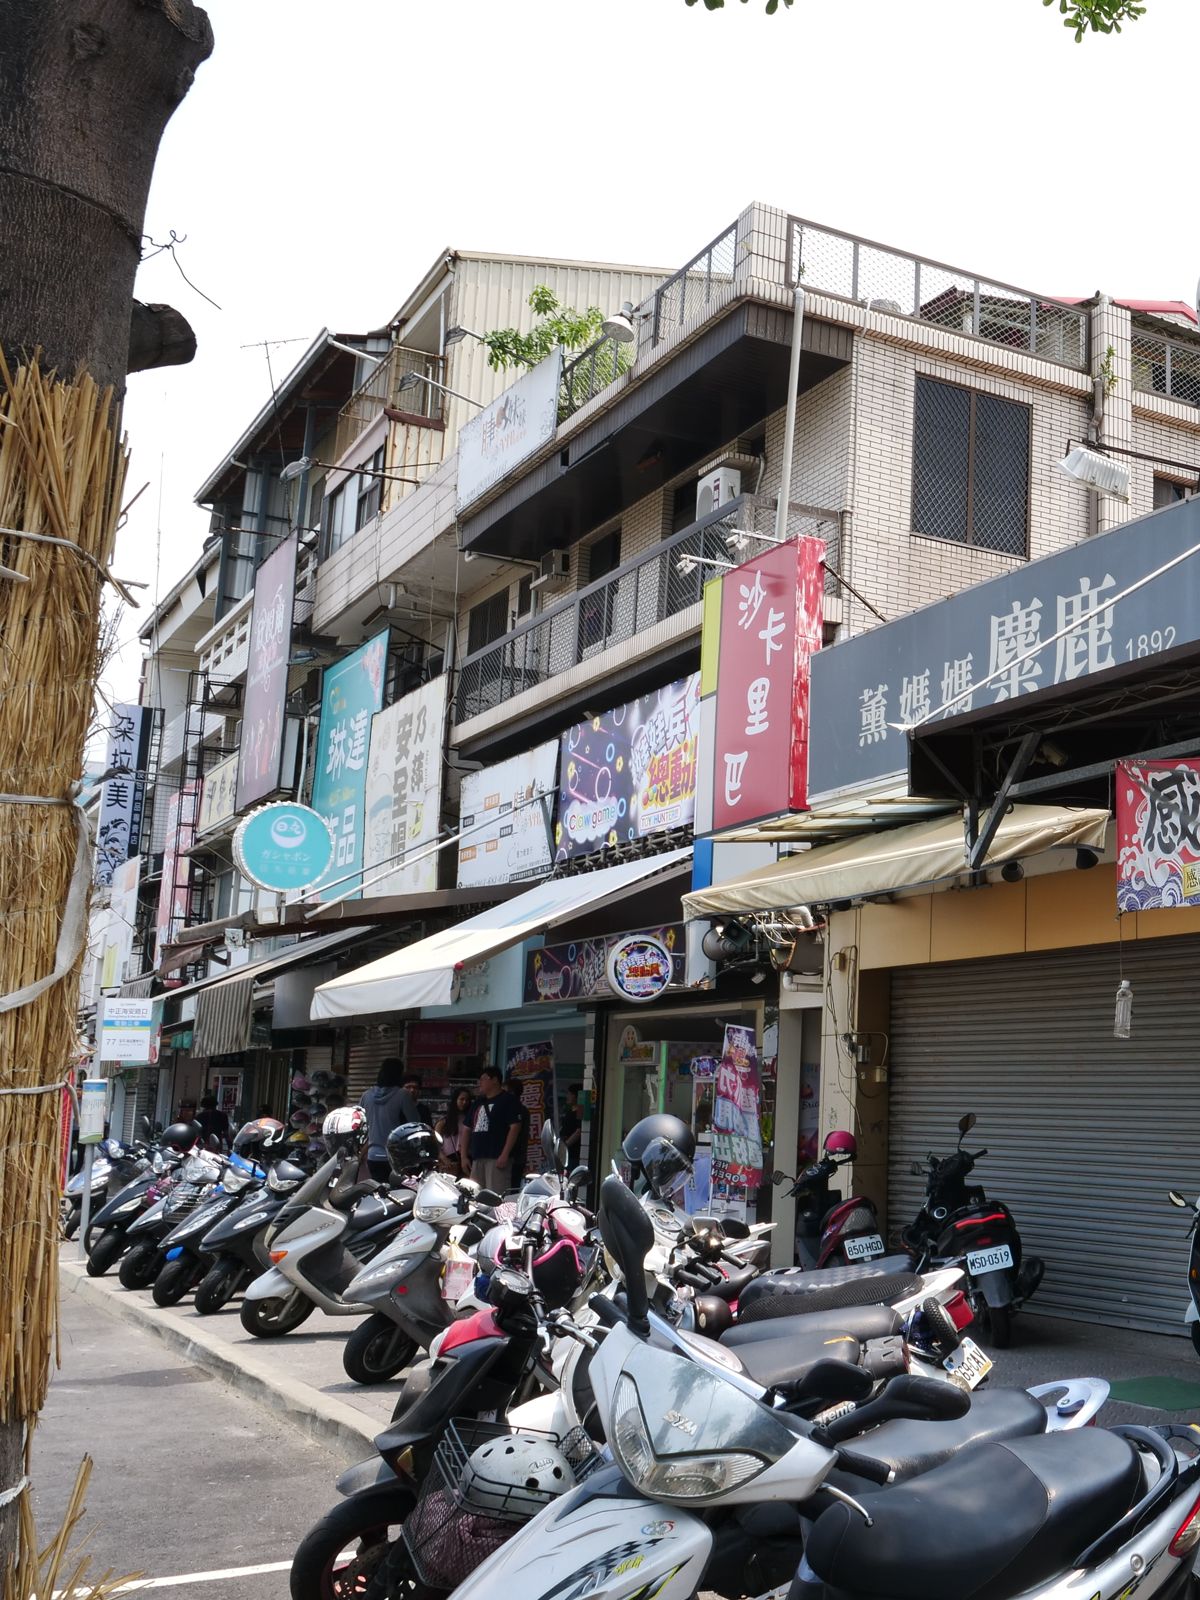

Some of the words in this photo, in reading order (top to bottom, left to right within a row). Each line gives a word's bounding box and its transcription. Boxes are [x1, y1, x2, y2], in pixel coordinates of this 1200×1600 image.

[1125, 625, 1178, 662] 1892
[724, 569, 787, 807] 沙卡里巴
[847, 1239, 883, 1257] 850-HGD
[968, 1250, 1010, 1271] MSD-0319
[662, 1409, 698, 1437] SYM
